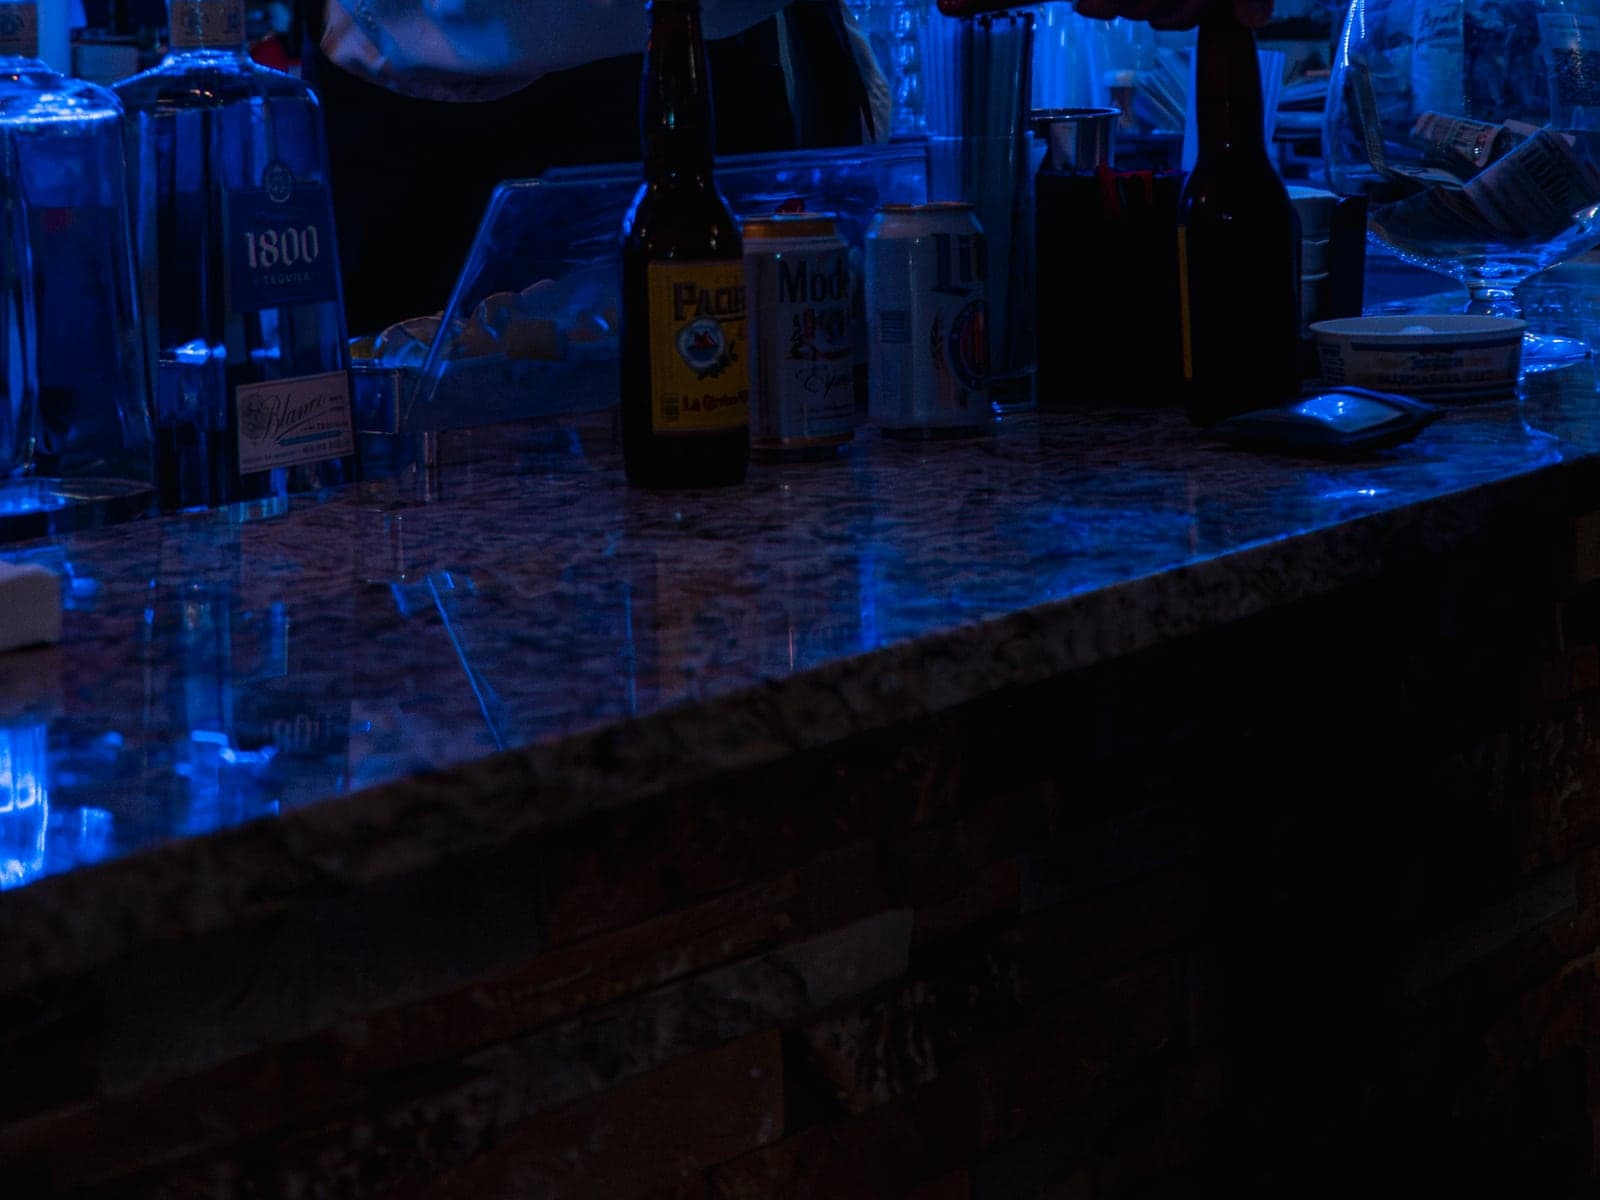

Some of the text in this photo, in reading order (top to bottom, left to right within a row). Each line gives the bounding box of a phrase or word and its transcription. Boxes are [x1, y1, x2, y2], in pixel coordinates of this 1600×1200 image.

[243, 225, 319, 269] 1800
[778, 260, 850, 302] Mod
[261, 392, 327, 442] Blanco
